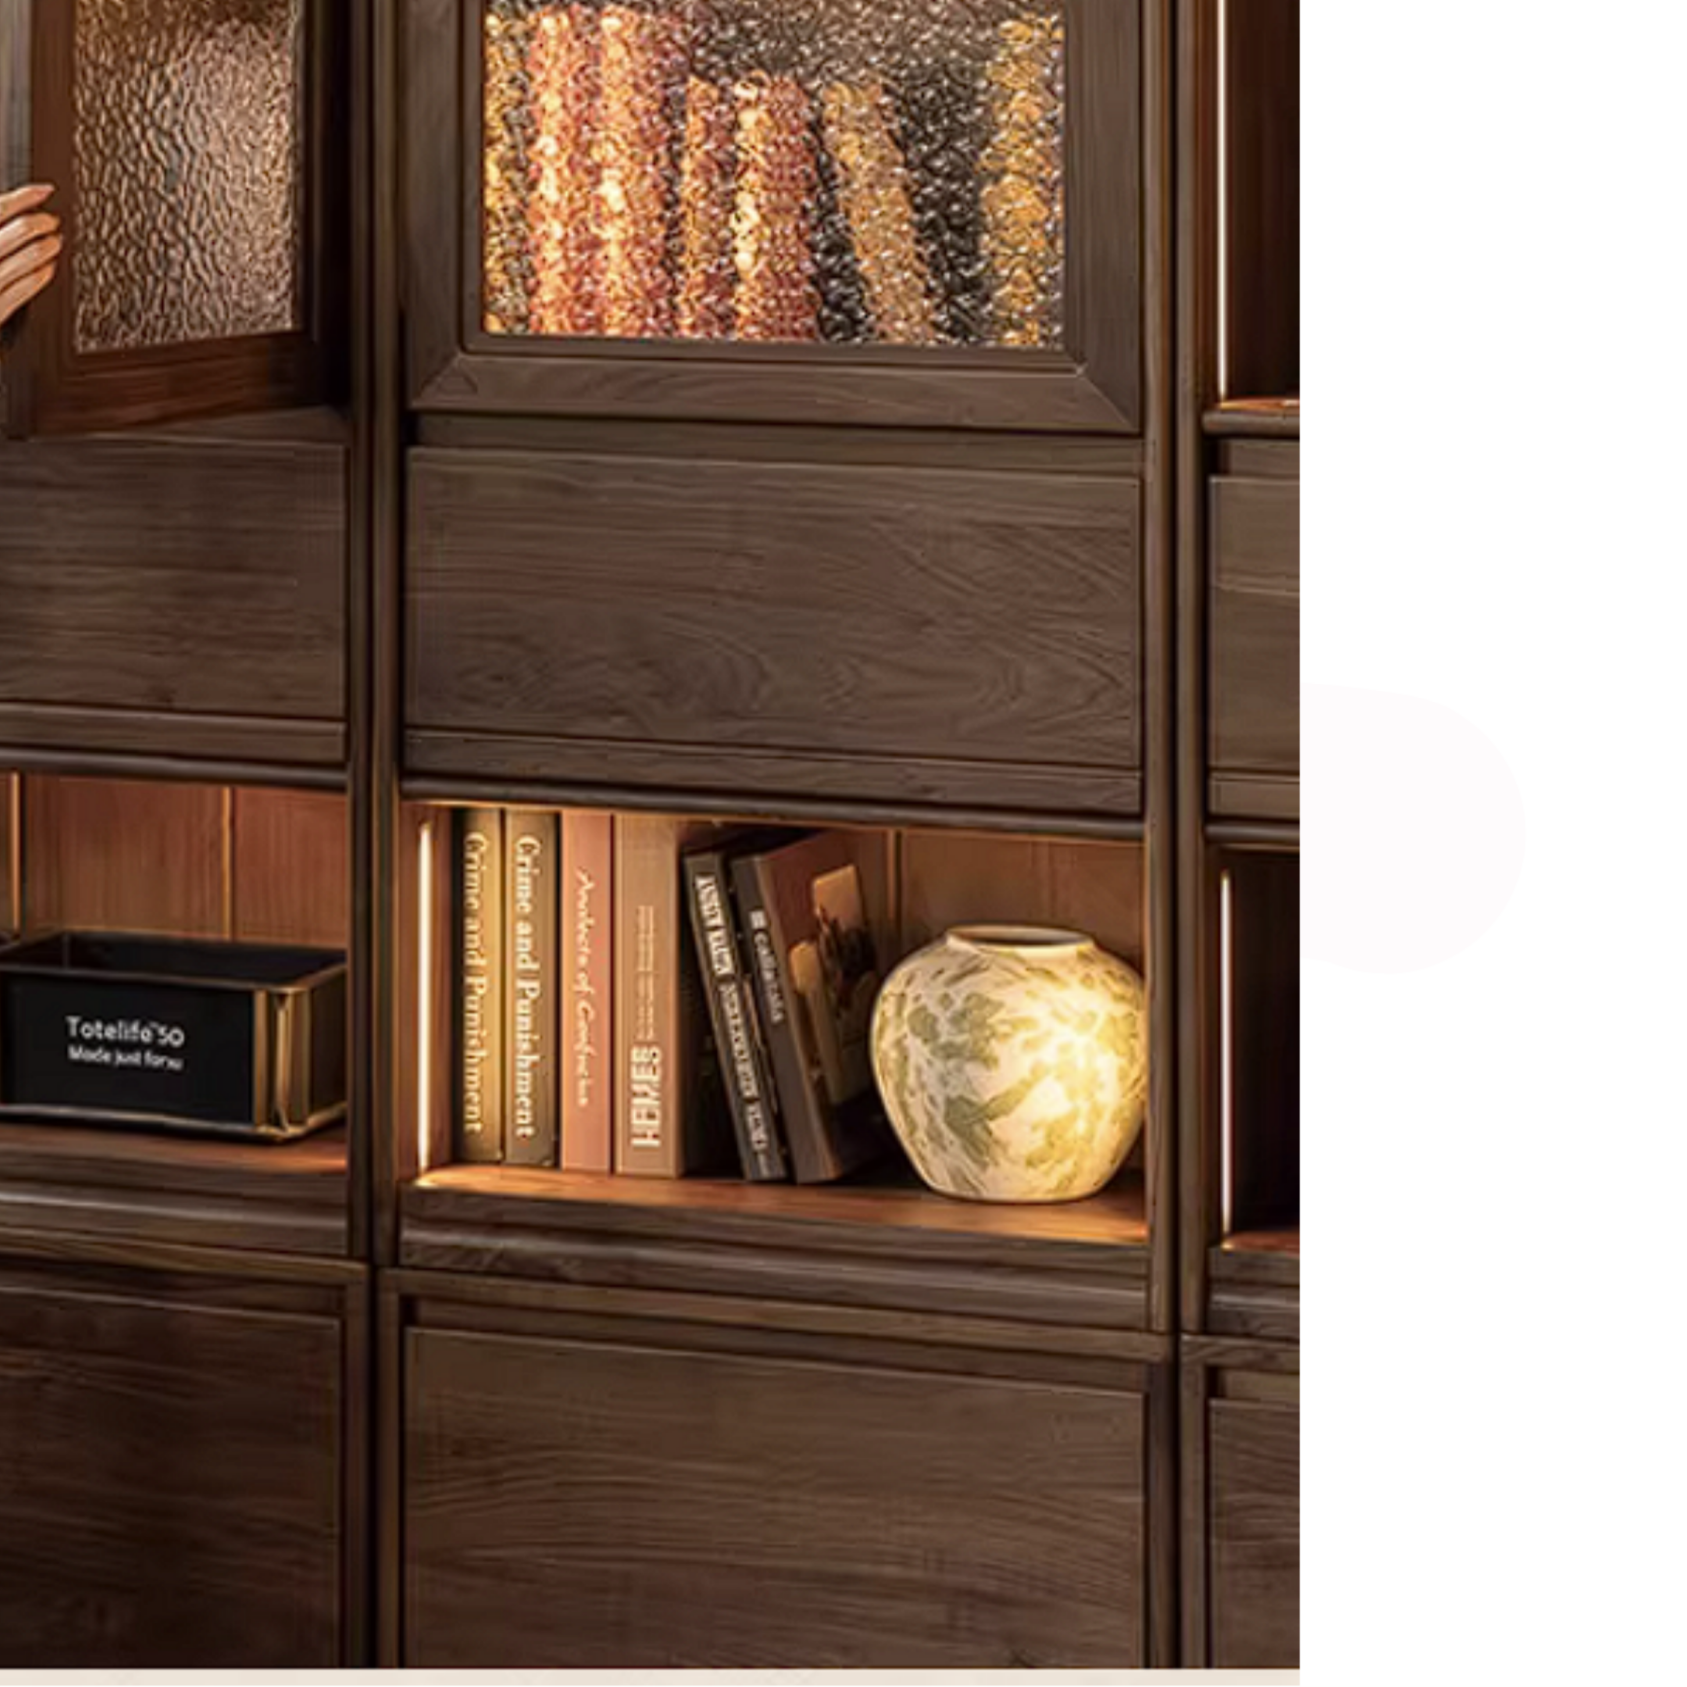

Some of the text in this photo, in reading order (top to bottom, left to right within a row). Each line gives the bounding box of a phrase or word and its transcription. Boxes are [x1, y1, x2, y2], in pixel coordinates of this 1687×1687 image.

[68, 1045, 112, 1064] Made
[465, 832, 489, 1133] Crime and Punishment
[515, 835, 541, 1138] Crime and Punishment
